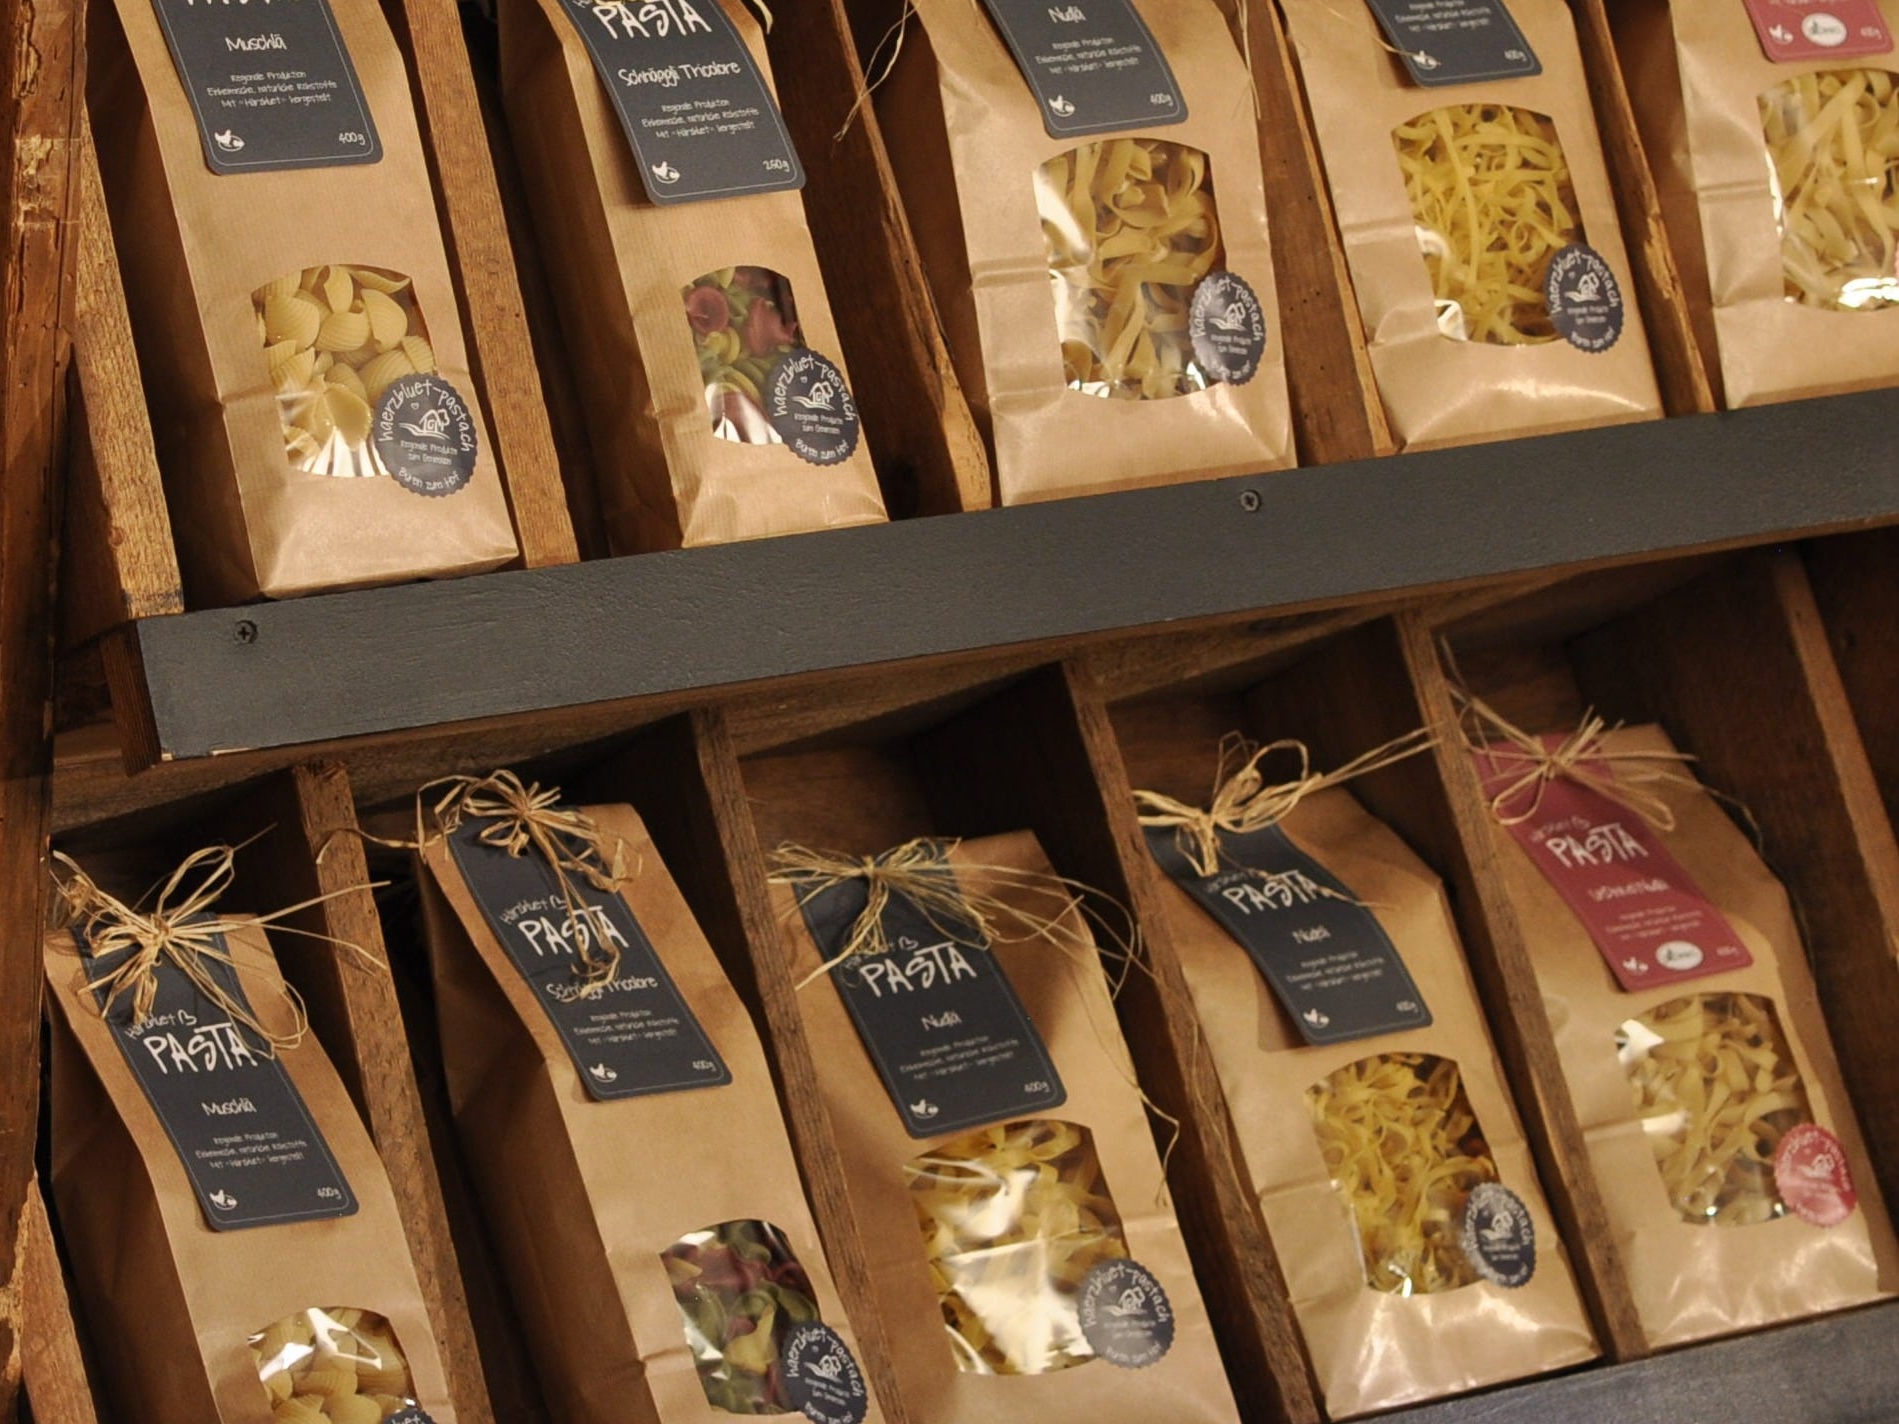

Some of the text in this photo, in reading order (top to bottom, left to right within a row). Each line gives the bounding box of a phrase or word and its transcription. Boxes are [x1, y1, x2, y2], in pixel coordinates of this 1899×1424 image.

[225, 34, 287, 52] Muschlä
[1546, 823, 1649, 868] PASTA
[859, 942, 977, 998] PASTA
[143, 1022, 258, 1074] PASTA
